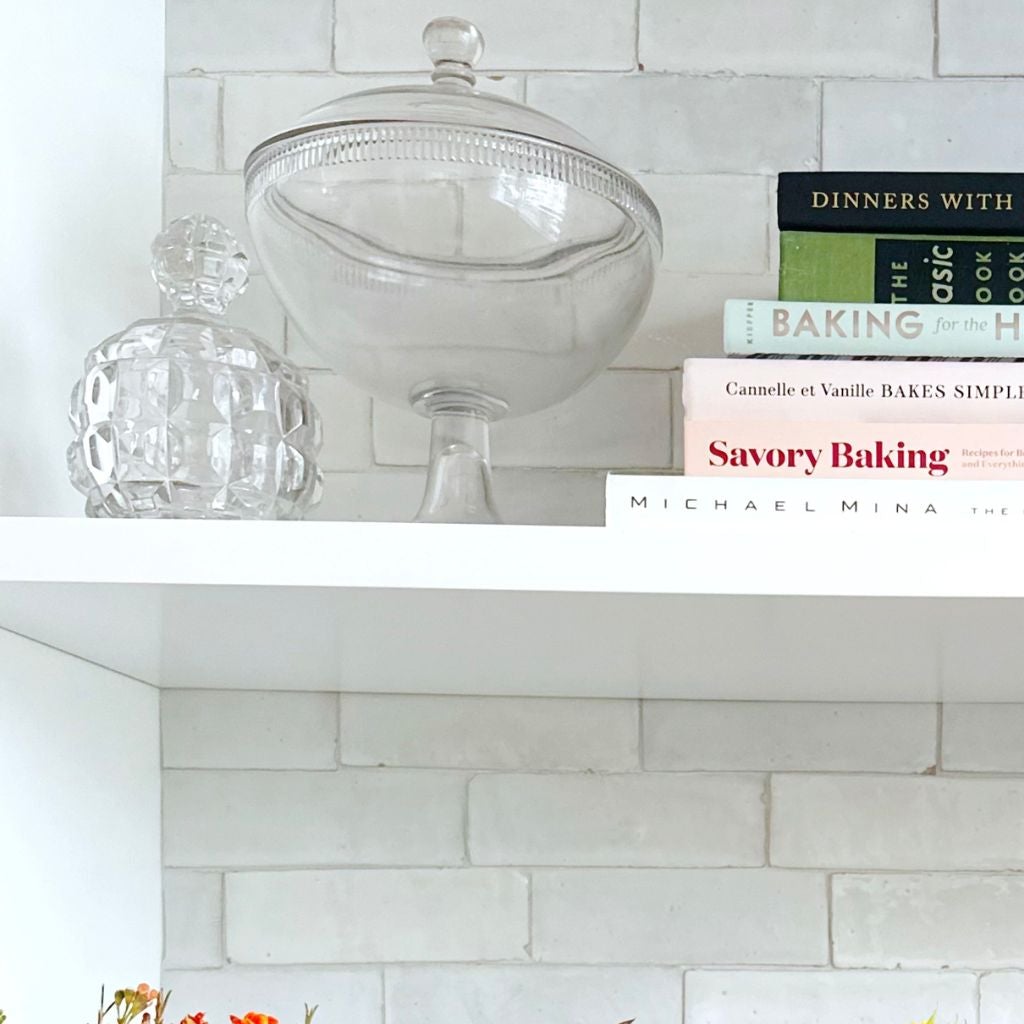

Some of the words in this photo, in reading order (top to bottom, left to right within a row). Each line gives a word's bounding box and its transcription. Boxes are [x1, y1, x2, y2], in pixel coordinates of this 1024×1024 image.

[811, 191, 930, 209] DINNERS
[940, 193, 1013, 210] WITH
[891, 261, 908, 304] THE
[923, 244, 954, 304] asic
[975, 251, 992, 303] OOK
[1008, 251, 1024, 304] OOK
[773, 308, 924, 340] BAKING
[933, 316, 959, 334] for
[963, 317, 988, 331] the
[725, 381, 796, 397] Cannelle
[800, 385, 816, 397] et
[820, 382, 874, 398] Vanille
[880, 383, 946, 399] BAKES
[708, 440, 823, 475] Savory
[831, 441, 950, 477] Baking
[961, 448, 998, 458] Recipes
[1000, 448, 1013, 457] for
[962, 460, 979, 468] and
[631, 496, 815, 512] MICHAEL
[841, 500, 937, 514] MINA
[971, 506, 1009, 516] THE
